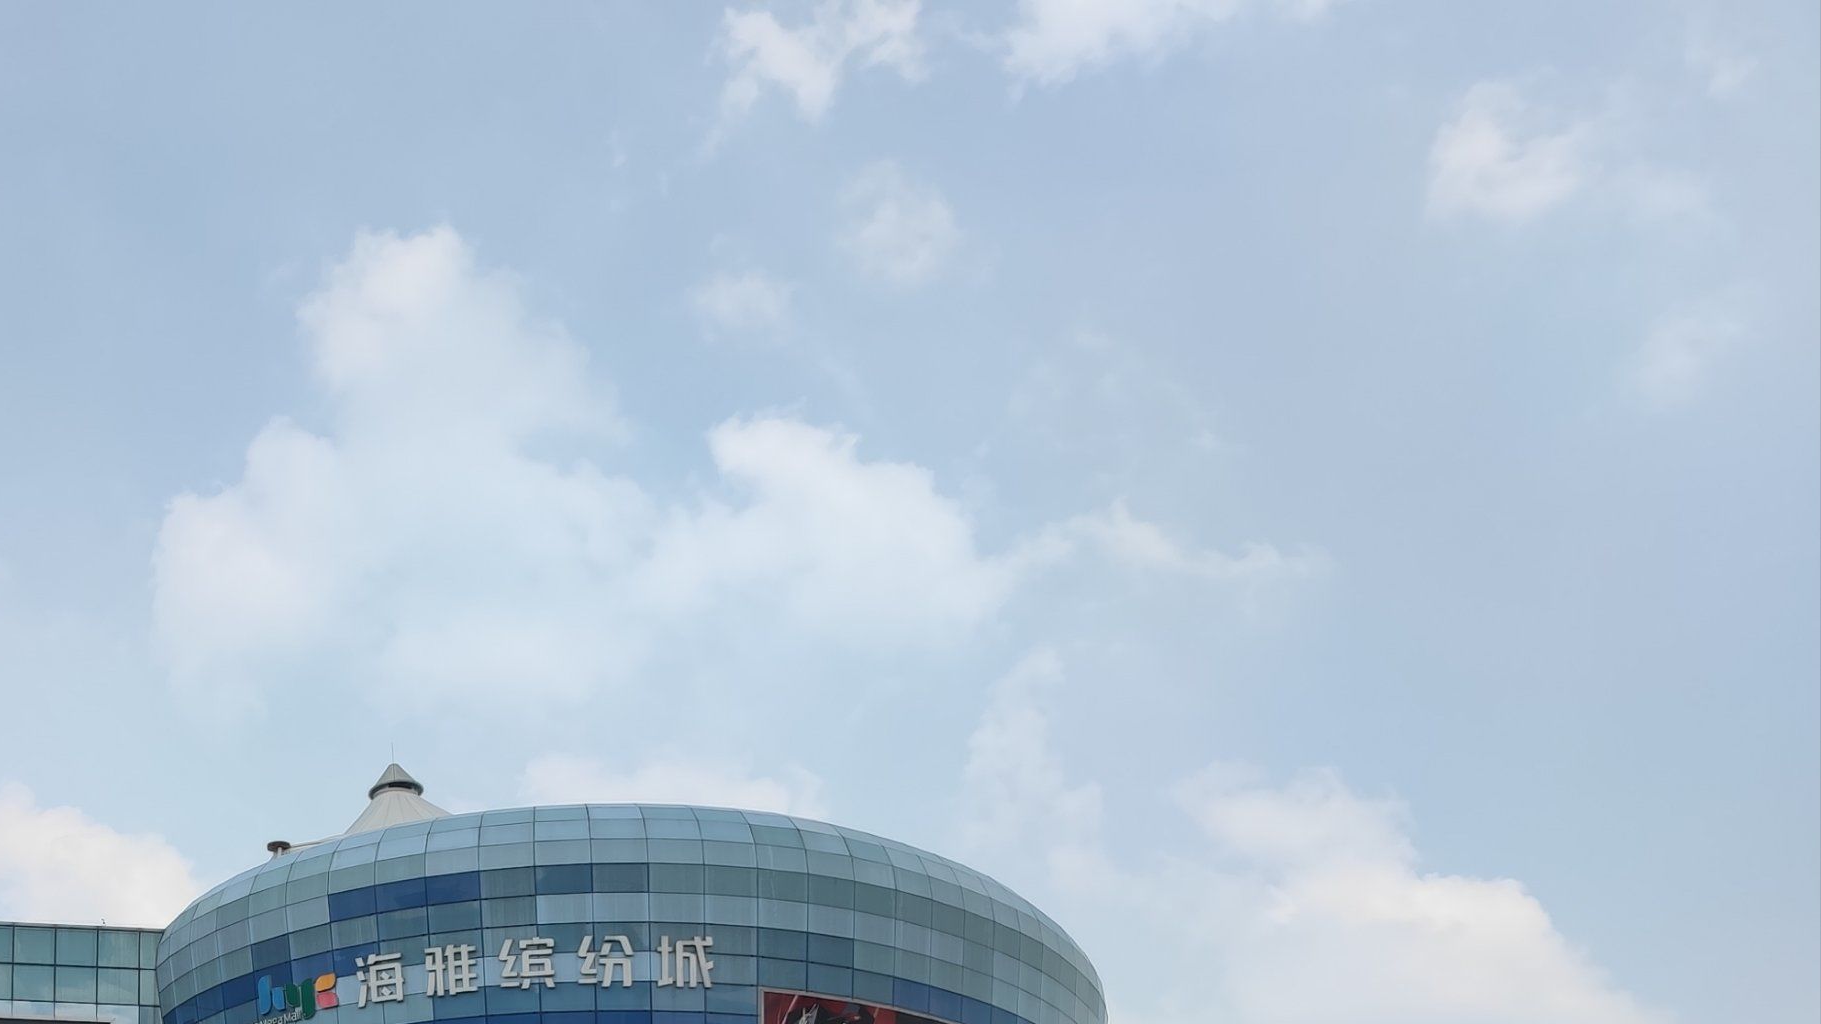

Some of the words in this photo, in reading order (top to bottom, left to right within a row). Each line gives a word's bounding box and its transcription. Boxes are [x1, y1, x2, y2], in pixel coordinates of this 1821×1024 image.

[354, 934, 715, 1008] 海雅缤纷城
